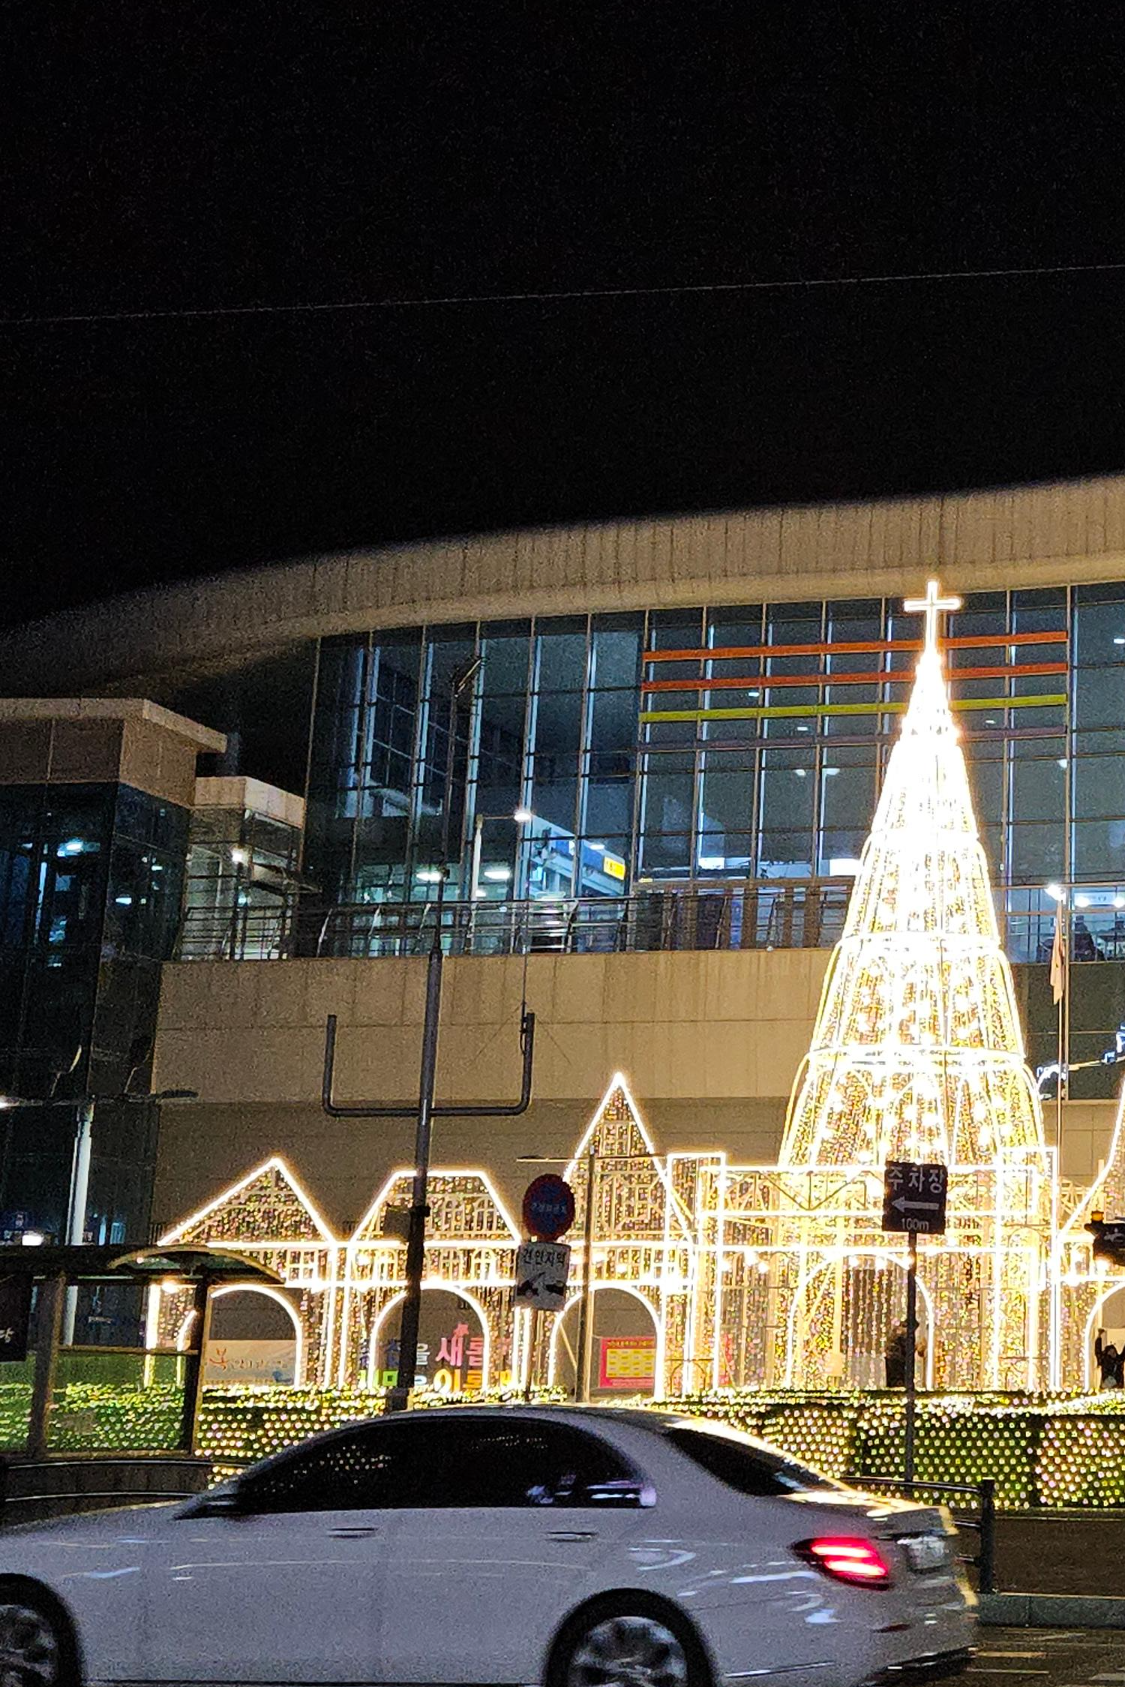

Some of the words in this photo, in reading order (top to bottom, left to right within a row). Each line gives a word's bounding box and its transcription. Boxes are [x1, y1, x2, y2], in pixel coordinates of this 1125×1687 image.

[887, 1166, 945, 1193] 주차장
[901, 1218, 929, 1231] 100m
[523, 1248, 567, 1267] 견인지역
